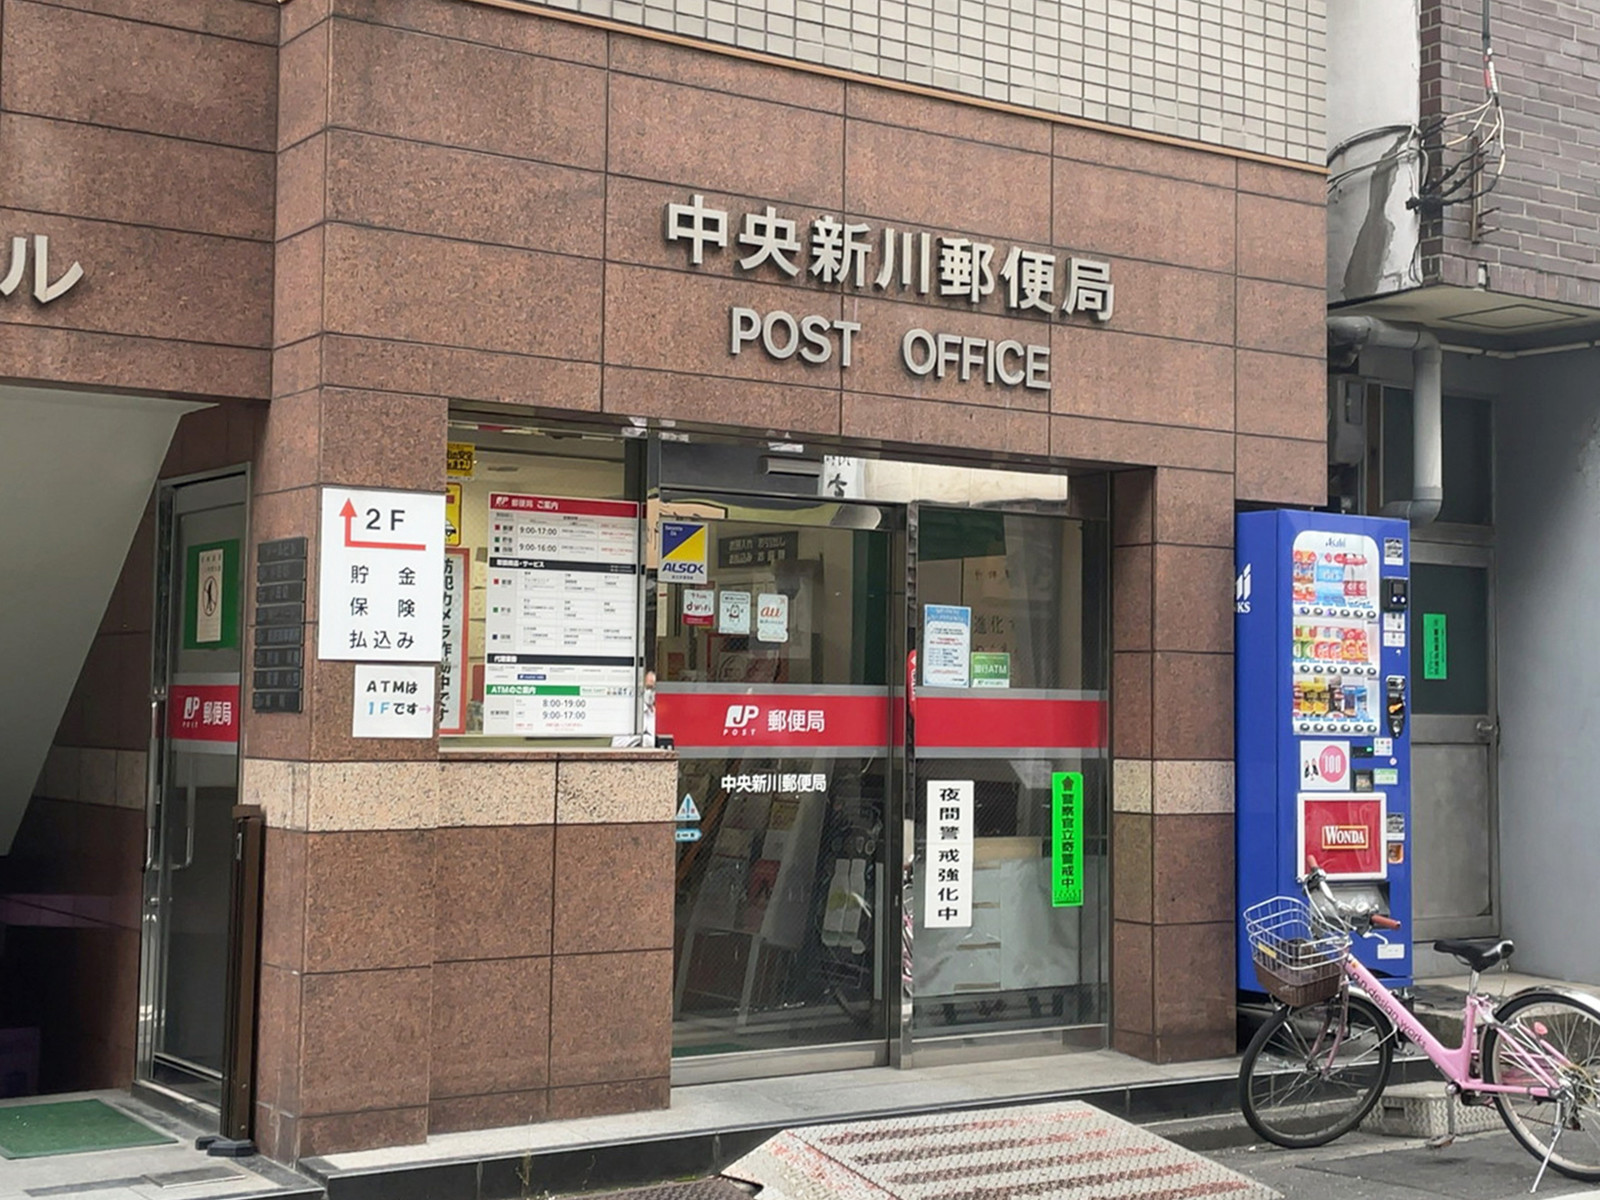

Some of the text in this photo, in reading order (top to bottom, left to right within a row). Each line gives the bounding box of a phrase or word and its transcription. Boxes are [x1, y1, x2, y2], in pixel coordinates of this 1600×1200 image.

[664, 194, 1115, 321] 中央新川郵便局
[730, 306, 1052, 390] POST OFFICE
[365, 507, 406, 532] 2F
[662, 561, 705, 575] ALSOK
[760, 606, 783, 618] au
[349, 630, 416, 650] 払込み
[366, 680, 419, 695] ATMは
[203, 701, 231, 726] 郵便局
[368, 701, 419, 716] 1Fです
[542, 699, 586, 708] 8:00-19:00
[542, 710, 586, 720] 9:00-17:00
[724, 705, 826, 733] JP 郵便局
[723, 728, 757, 736] POST
[720, 773, 827, 793] 中央新川郵便局
[1324, 825, 1365, 845] WONDA
[937, 787, 961, 921] 夜間警戒強化中
